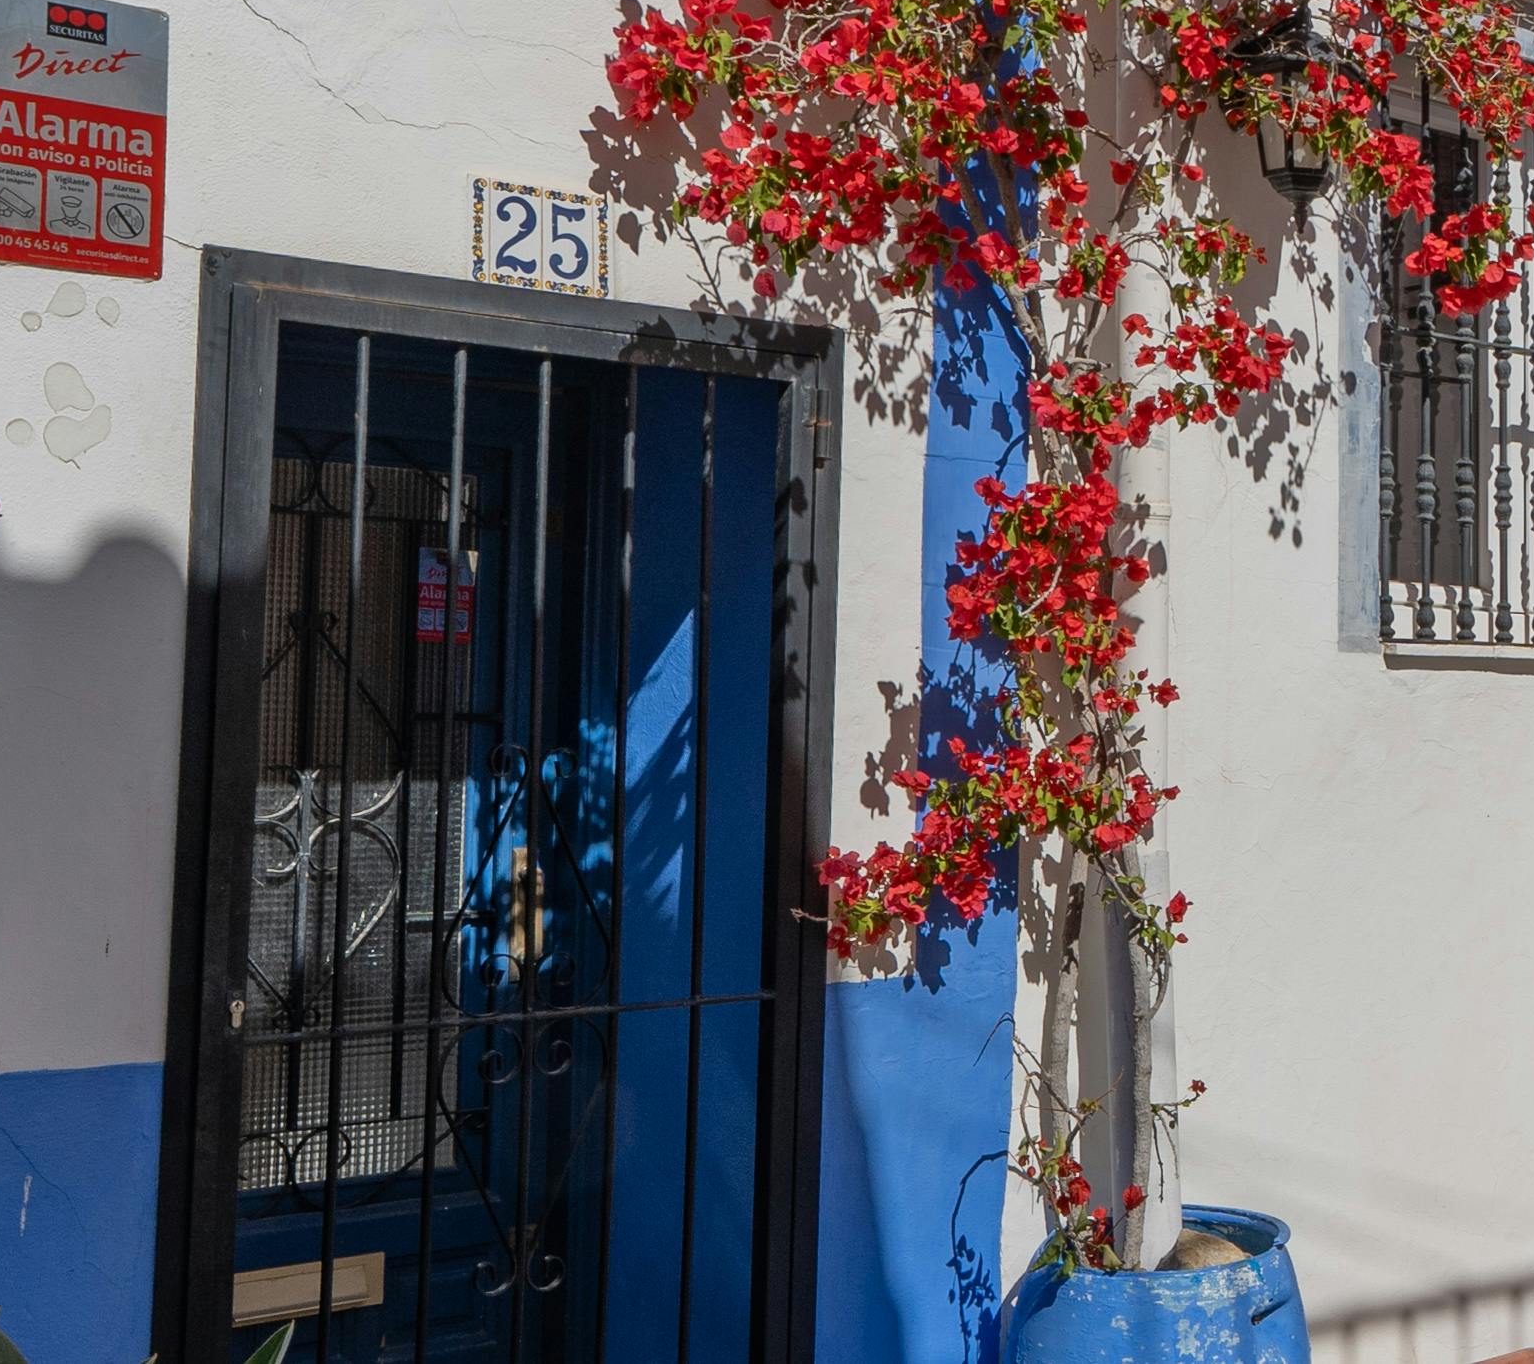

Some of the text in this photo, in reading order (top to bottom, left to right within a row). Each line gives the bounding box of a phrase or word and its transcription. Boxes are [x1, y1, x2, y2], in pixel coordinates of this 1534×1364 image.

[49, 24, 105, 42] SECURITAS
[12, 42, 142, 79] Direct
[28, 145, 75, 165] aviso
[79, 155, 91, 168] a
[95, 155, 154, 177] Policía
[54, 175, 91, 187] Vigilante
[112, 184, 141, 194] Alarma
[15, 237, 32, 249] 45
[33, 239, 51, 251] 45
[51, 241, 69, 254] 45
[496, 196, 589, 280] 25
[76, 248, 150, 264] securitasdirect.es
[419, 585, 470, 601] Alaa
